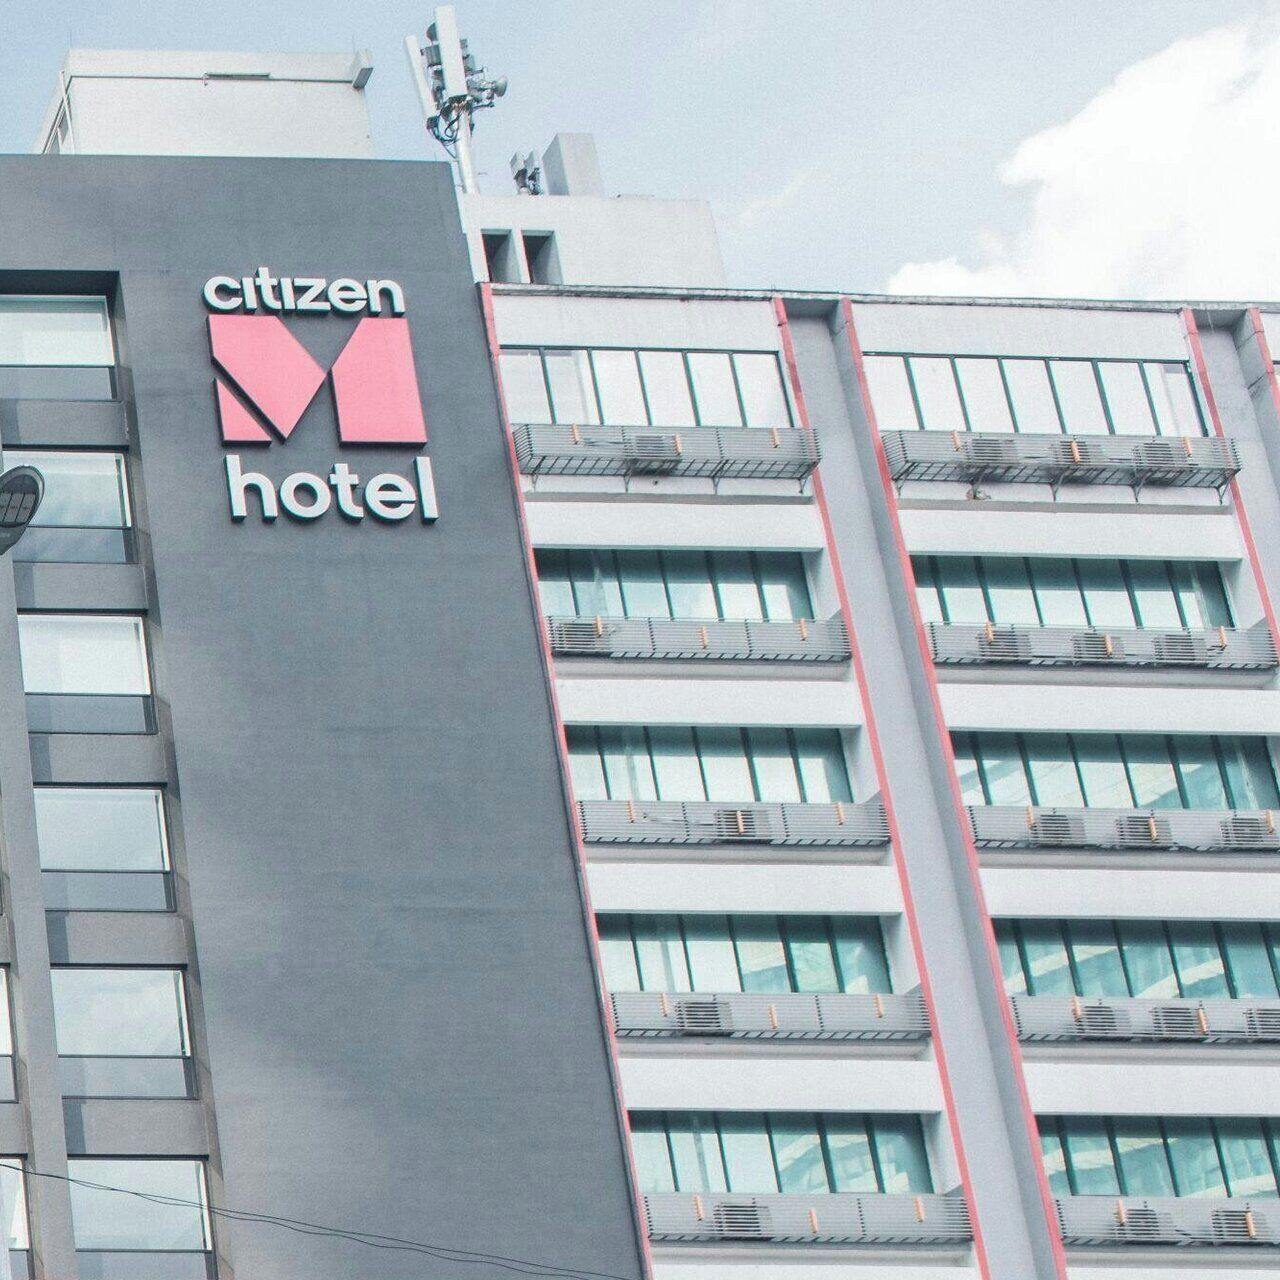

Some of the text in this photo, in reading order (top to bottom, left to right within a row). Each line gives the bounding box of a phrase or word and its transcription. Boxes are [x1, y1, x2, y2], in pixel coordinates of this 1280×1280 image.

[201, 266, 406, 317] citizen
[205, 313, 427, 447] M
[223, 454, 439, 525] hotel
